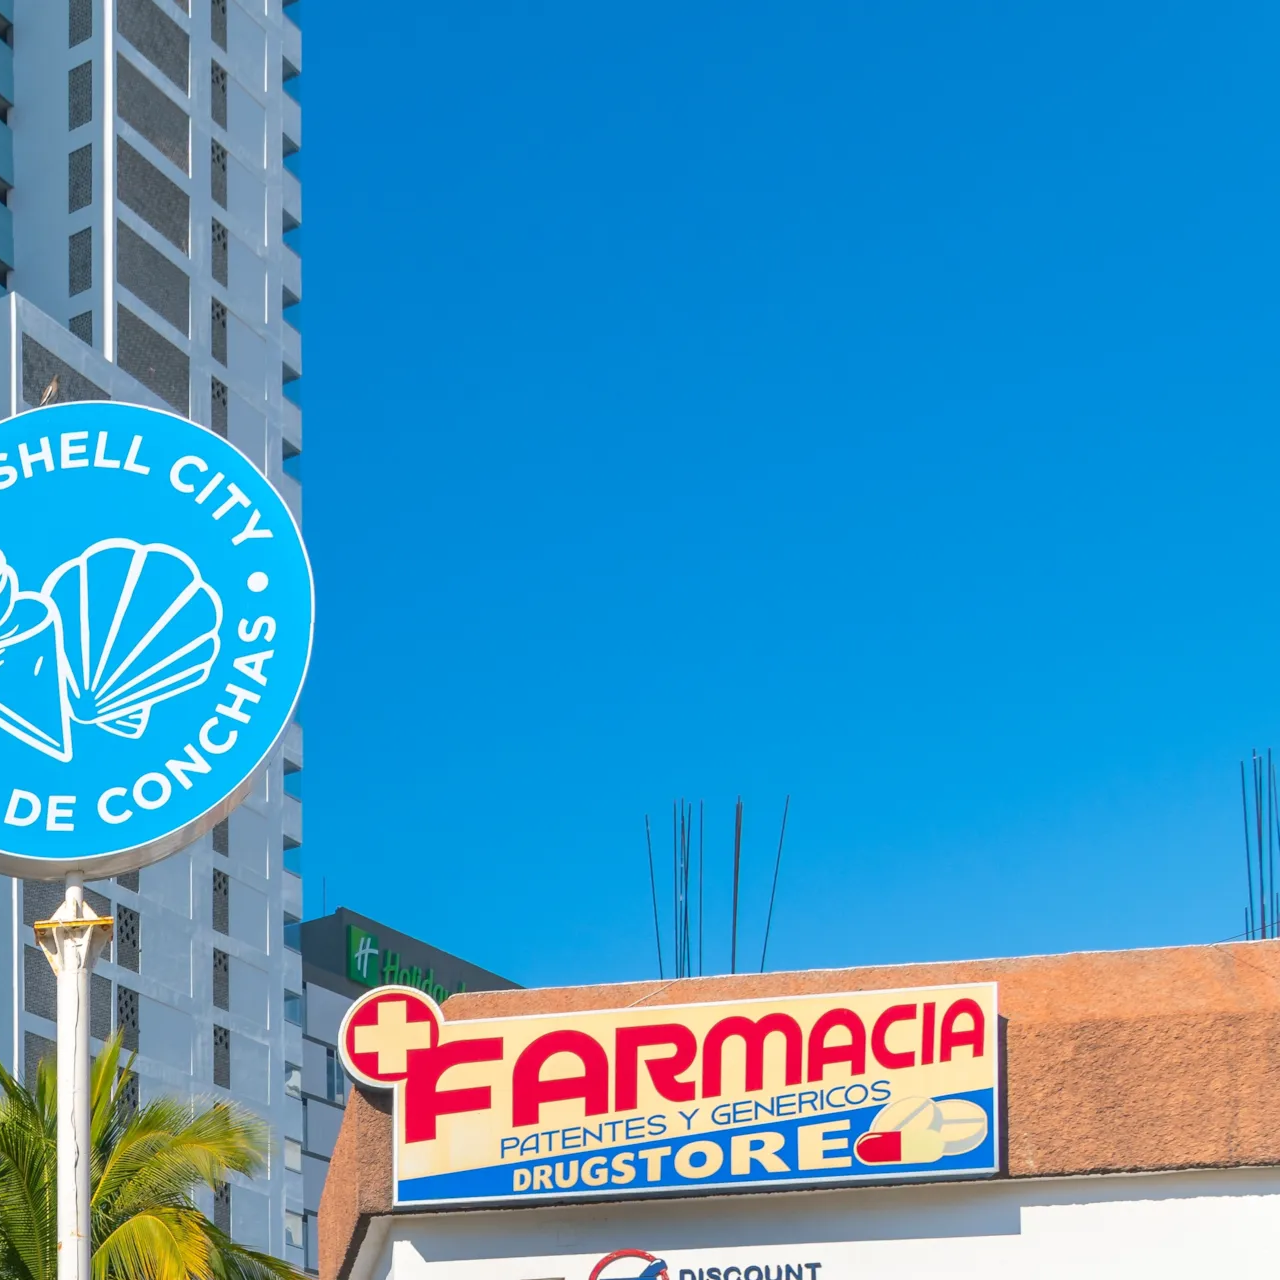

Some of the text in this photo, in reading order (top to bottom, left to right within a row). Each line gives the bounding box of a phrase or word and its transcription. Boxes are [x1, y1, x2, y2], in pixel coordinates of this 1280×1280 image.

[169, 455, 274, 547] CITY
[3, 789, 77, 832] DE
[96, 615, 277, 825] CONCHAS
[405, 997, 985, 1144] FARMACIA
[500, 1079, 892, 1160] PATENTES Y GENERICOS
[512, 1117, 852, 1193] DRUGSTORE
